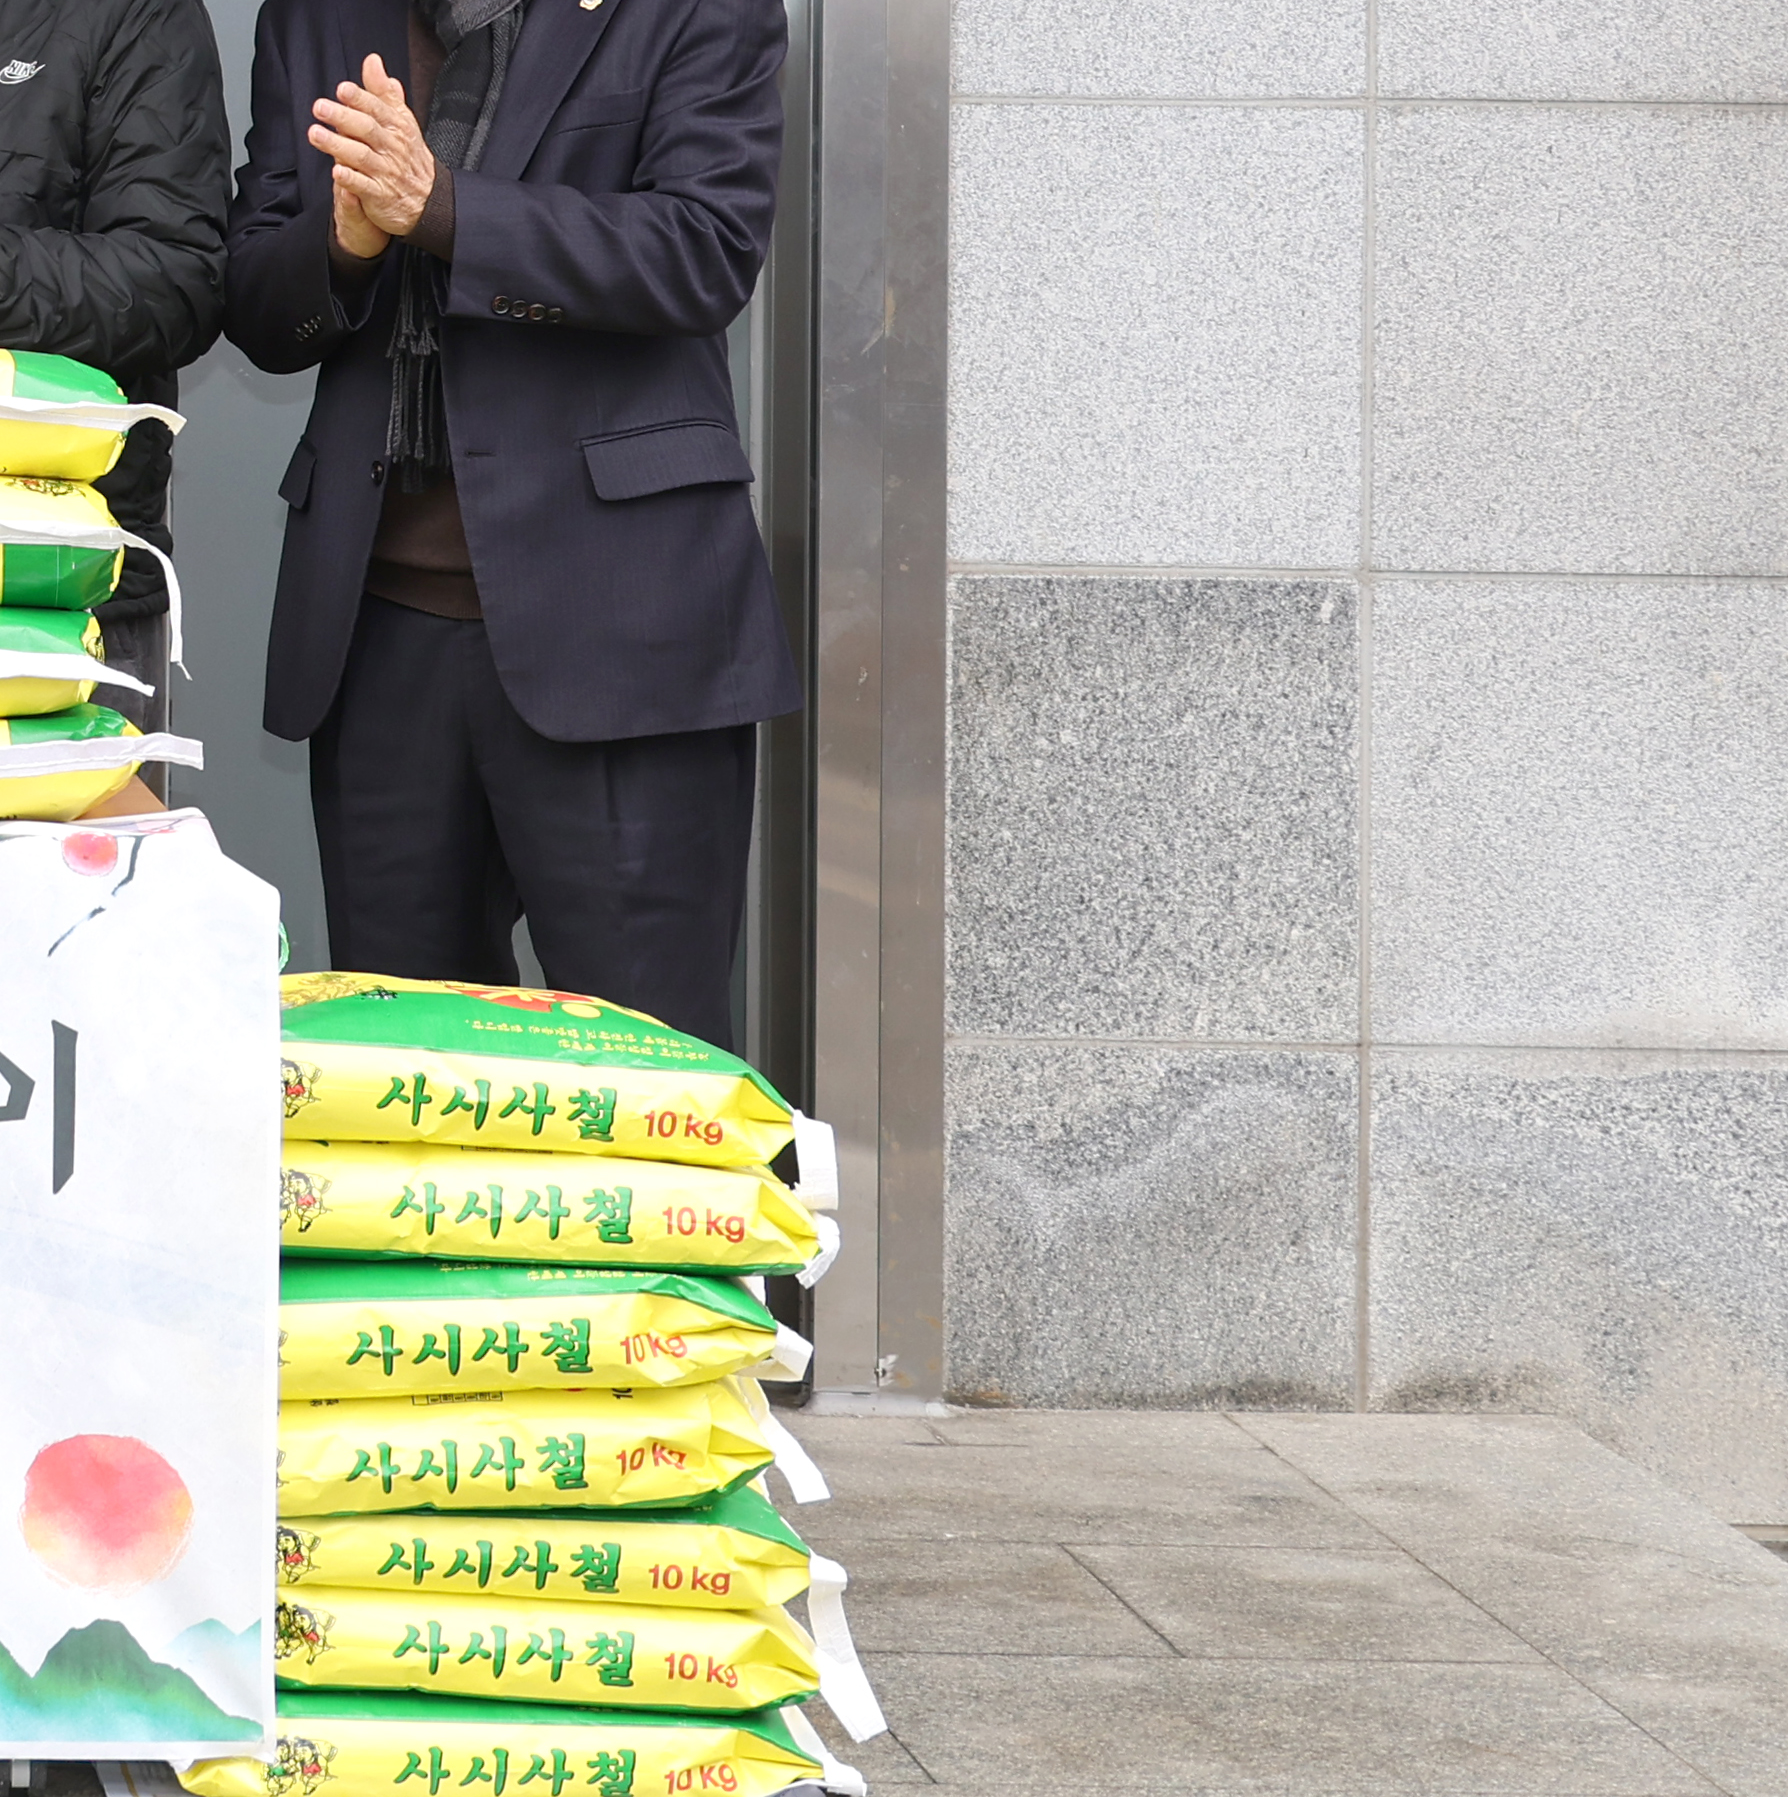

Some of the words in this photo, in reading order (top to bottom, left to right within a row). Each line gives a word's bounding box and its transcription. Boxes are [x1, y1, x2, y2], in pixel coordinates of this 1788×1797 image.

[377, 1072, 616, 1142] 사시사철
[646, 1111, 677, 1137] 10
[686, 1115, 723, 1145] kg
[391, 1182, 633, 1244] 사시사철
[664, 1207, 696, 1235] 10
[707, 1210, 745, 1243] kg
[347, 1318, 594, 1376] 사시사철
[622, 1336, 643, 1363] 10
[647, 1335, 685, 1358] kg
[346, 1433, 589, 1493] 사시사철
[616, 1448, 645, 1476] 10
[378, 1538, 622, 1593] 사시사철
[651, 1566, 683, 1589] 10
[693, 1568, 730, 1593] kg
[393, 1621, 635, 1687] 사시사철
[667, 1654, 698, 1679] 10
[393, 1746, 637, 1797] 사시사철
[666, 1772, 692, 1793] 10
[701, 1766, 737, 1792] kg
